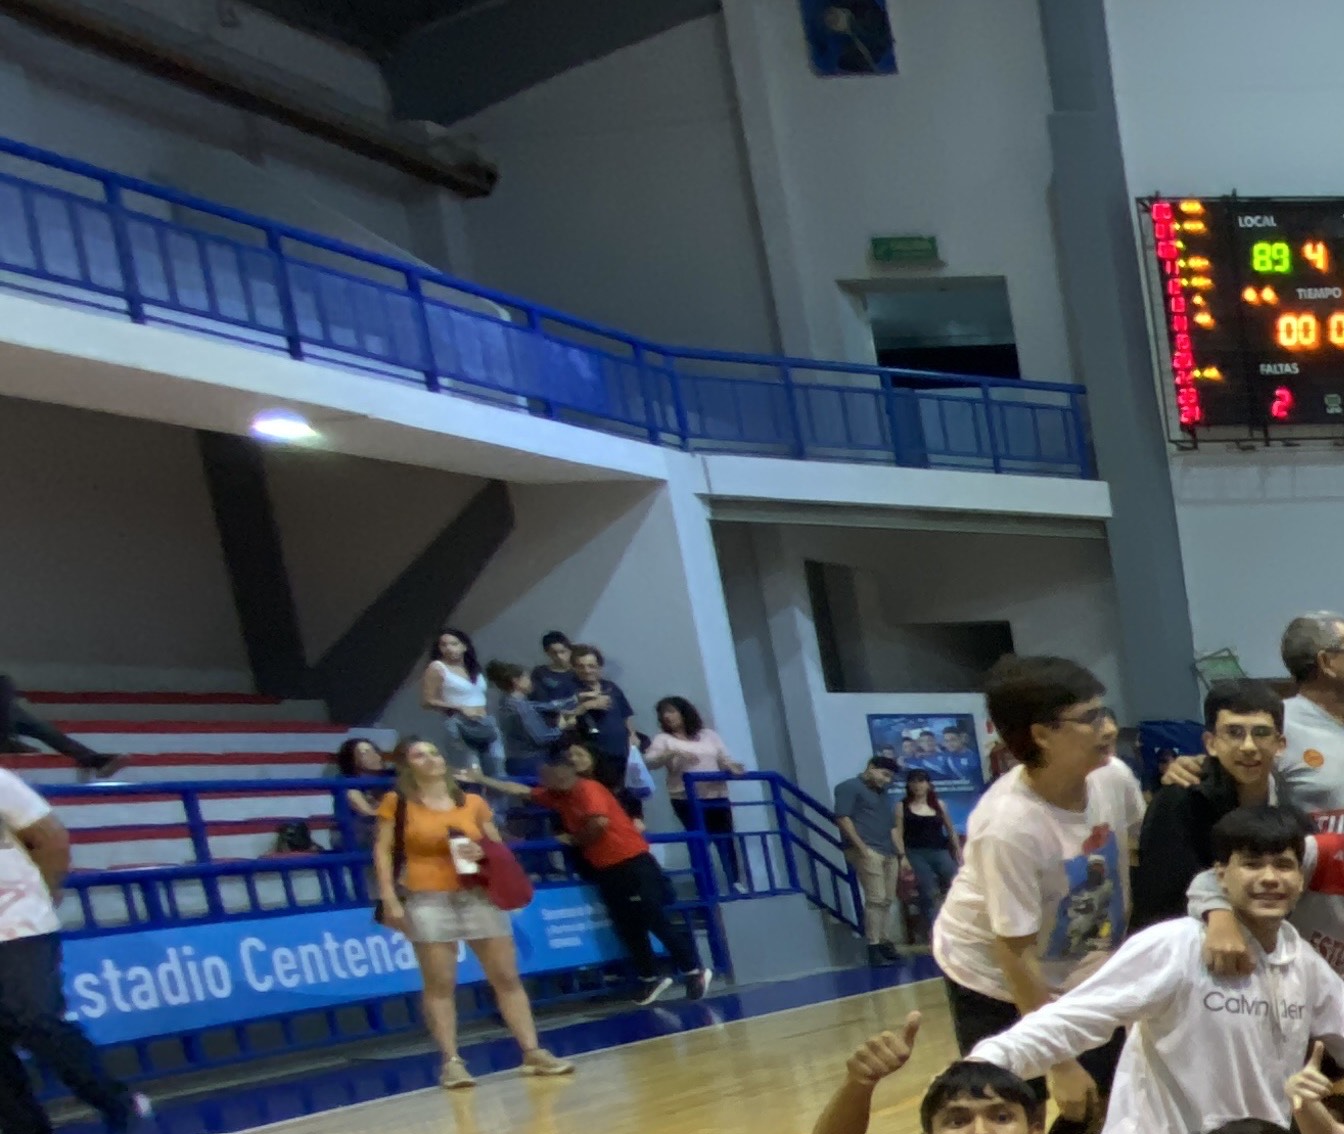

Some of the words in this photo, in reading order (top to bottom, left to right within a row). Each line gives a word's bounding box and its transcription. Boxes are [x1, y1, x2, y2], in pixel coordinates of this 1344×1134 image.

[1238, 215, 1277, 228] LOCAL
[1252, 241, 1291, 273] 89
[1303, 240, 1327, 272] 4
[1296, 286, 1342, 300] TIEMPO
[1259, 362, 1299, 375] FALTAS
[1271, 385, 1294, 420] 2
[63, 944, 233, 1022] stadio
[239, 931, 466, 992] Centena
[1203, 991, 1268, 1017] Calvin
